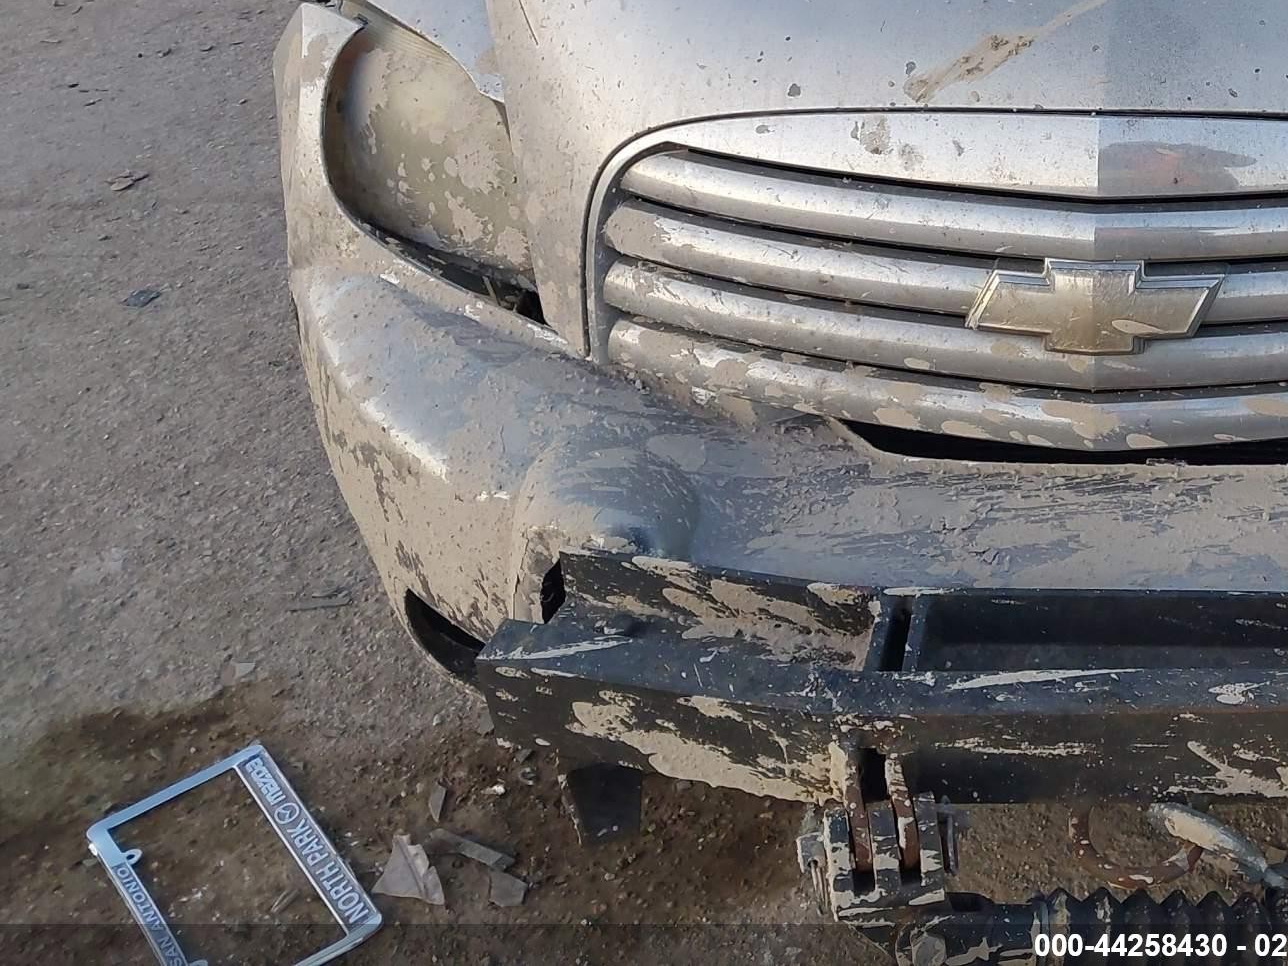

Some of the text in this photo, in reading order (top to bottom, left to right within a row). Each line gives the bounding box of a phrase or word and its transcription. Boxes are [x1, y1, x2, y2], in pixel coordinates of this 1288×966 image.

[245, 757, 370, 924] NORTH PARK mazda
[116, 867, 165, 932] ANTONIO
